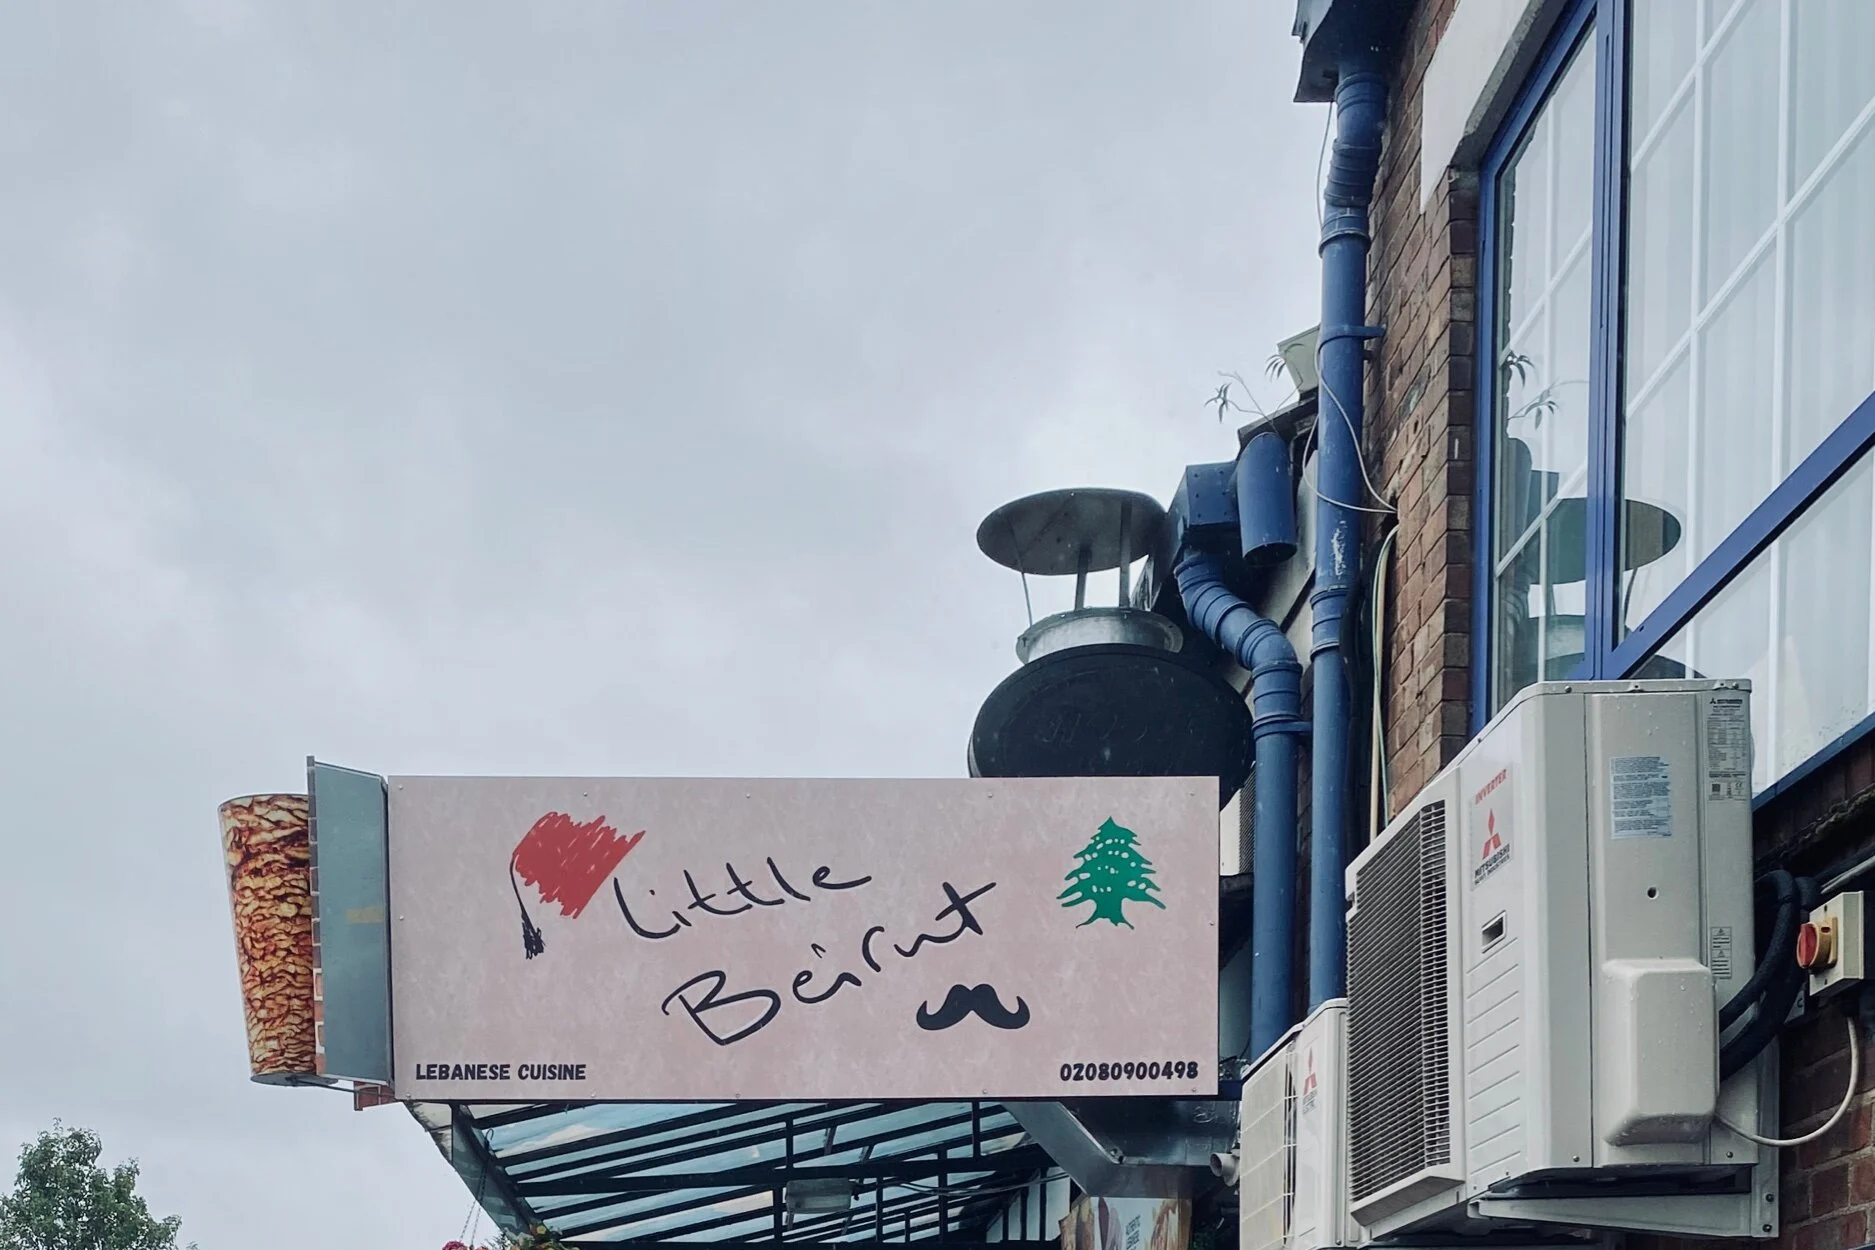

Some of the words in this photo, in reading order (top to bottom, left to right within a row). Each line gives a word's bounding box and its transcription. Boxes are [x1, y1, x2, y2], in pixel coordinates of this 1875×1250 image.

[613, 856, 873, 940] Little
[661, 880, 997, 1045] Beirut
[415, 1063, 511, 1081] LEBANESE
[517, 1063, 587, 1081] CUISINE
[1059, 1060, 1199, 1082] 02080900498
